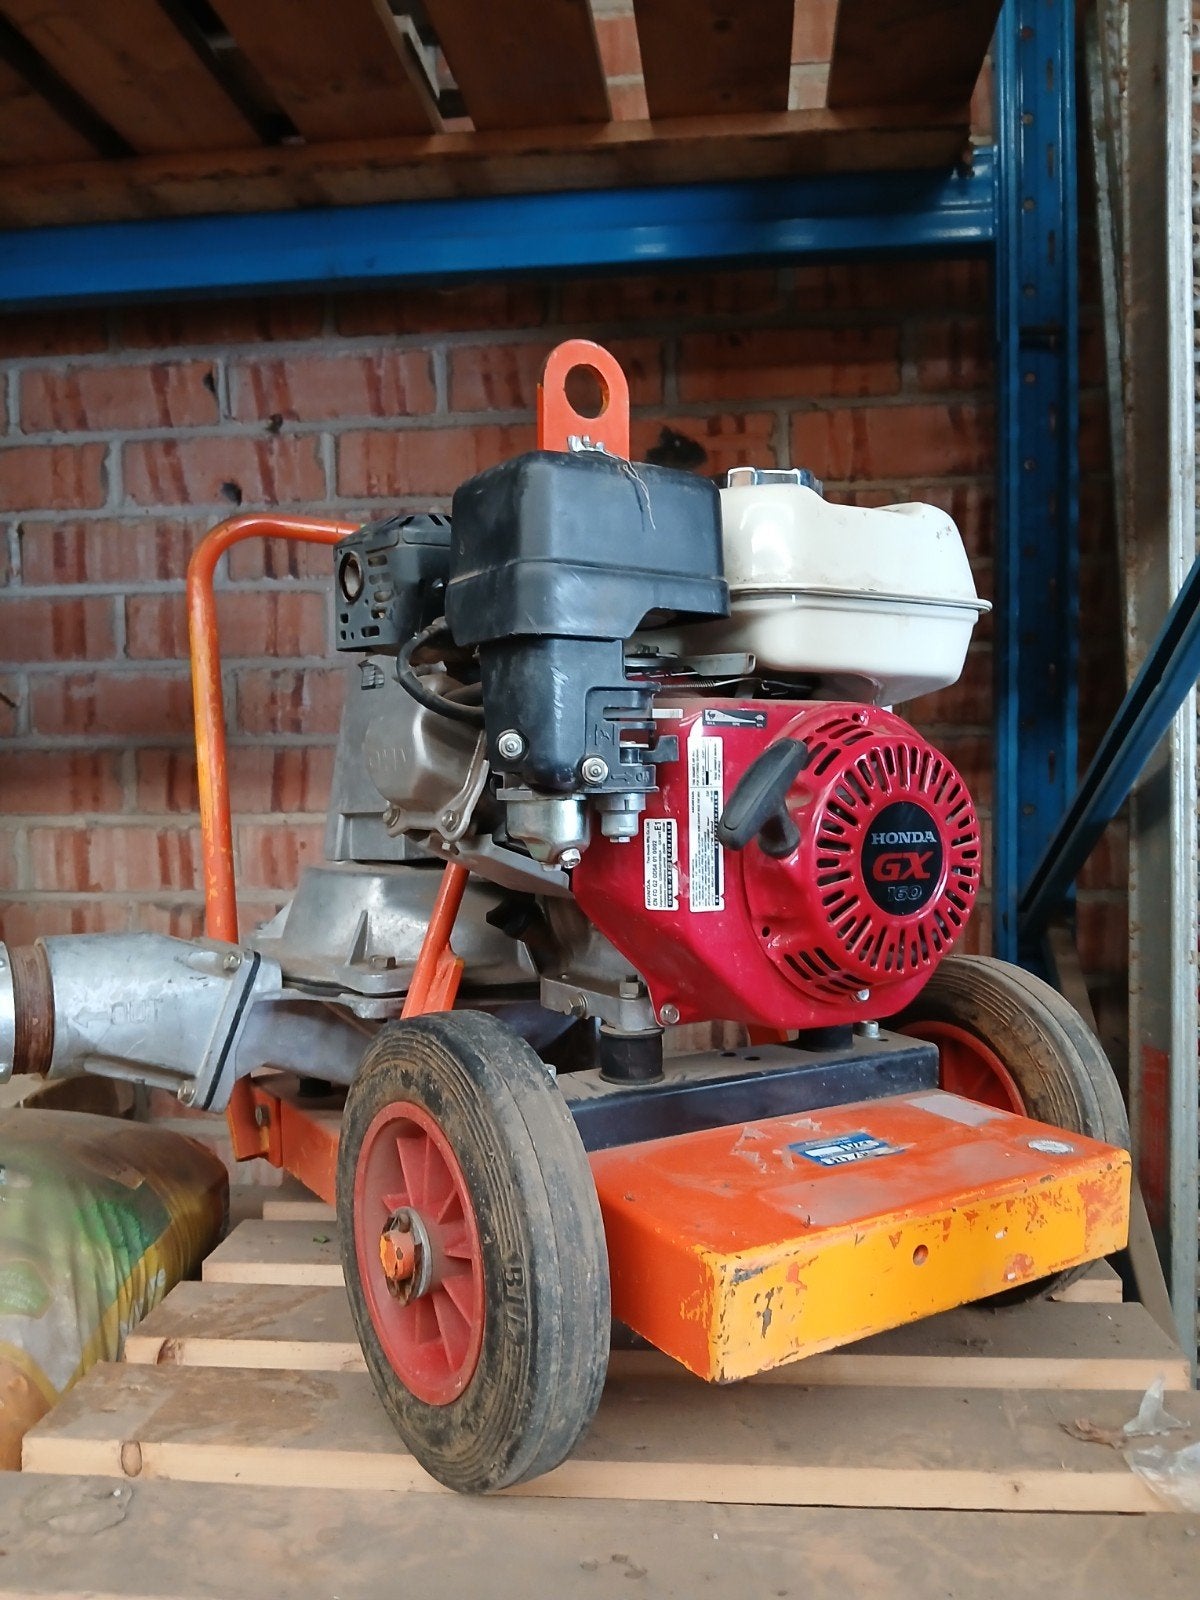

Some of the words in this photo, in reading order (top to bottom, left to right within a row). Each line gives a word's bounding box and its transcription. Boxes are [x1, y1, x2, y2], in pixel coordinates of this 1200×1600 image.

[654, 821, 661, 831] E1
[871, 831, 937, 844] HONDA
[873, 851, 934, 882] GX
[888, 885, 922, 902] 160
[111, 999, 163, 1025] OUT
